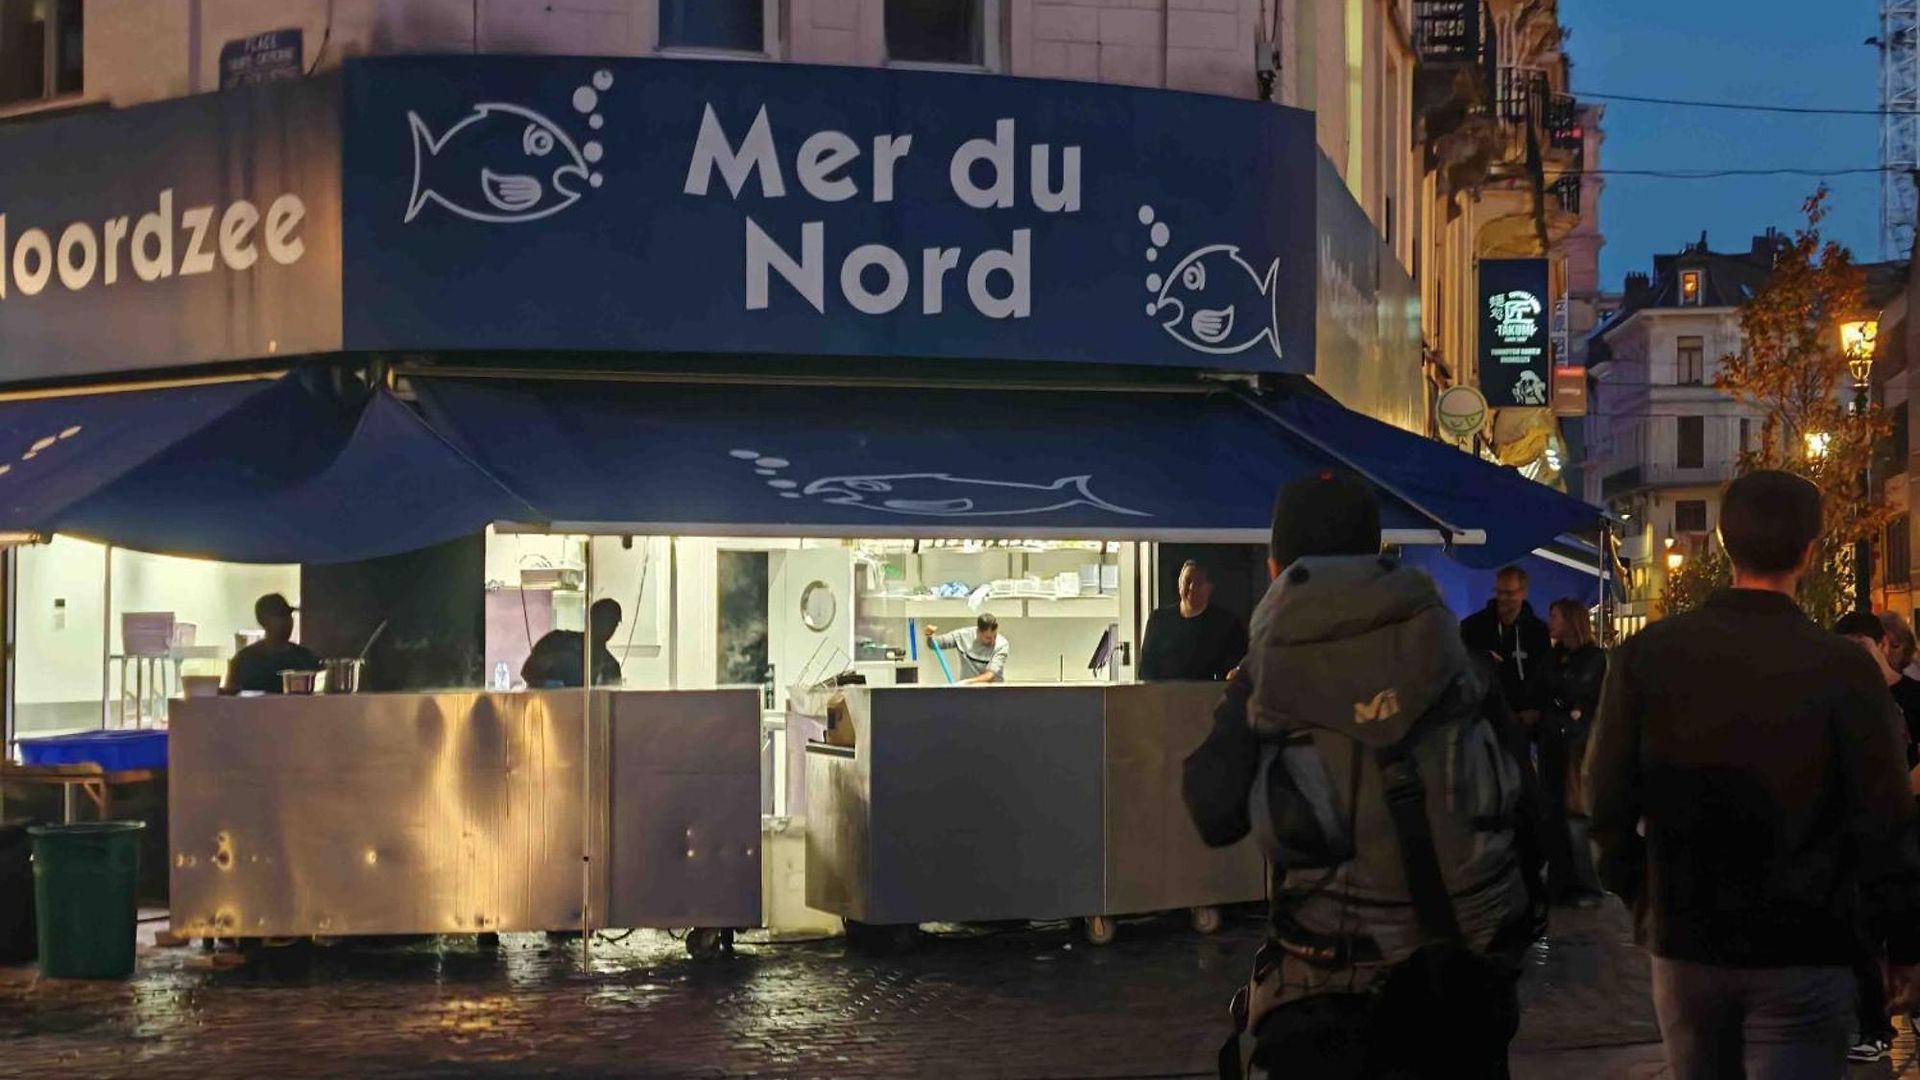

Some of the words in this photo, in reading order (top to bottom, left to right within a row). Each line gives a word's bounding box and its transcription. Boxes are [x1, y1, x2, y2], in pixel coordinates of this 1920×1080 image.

[685, 103, 912, 201] Mer
[950, 118, 1081, 212] du
[0, 191, 305, 299] oordzee
[746, 217, 1031, 318] Nord
[1497, 323, 1535, 337] TAKUMI
